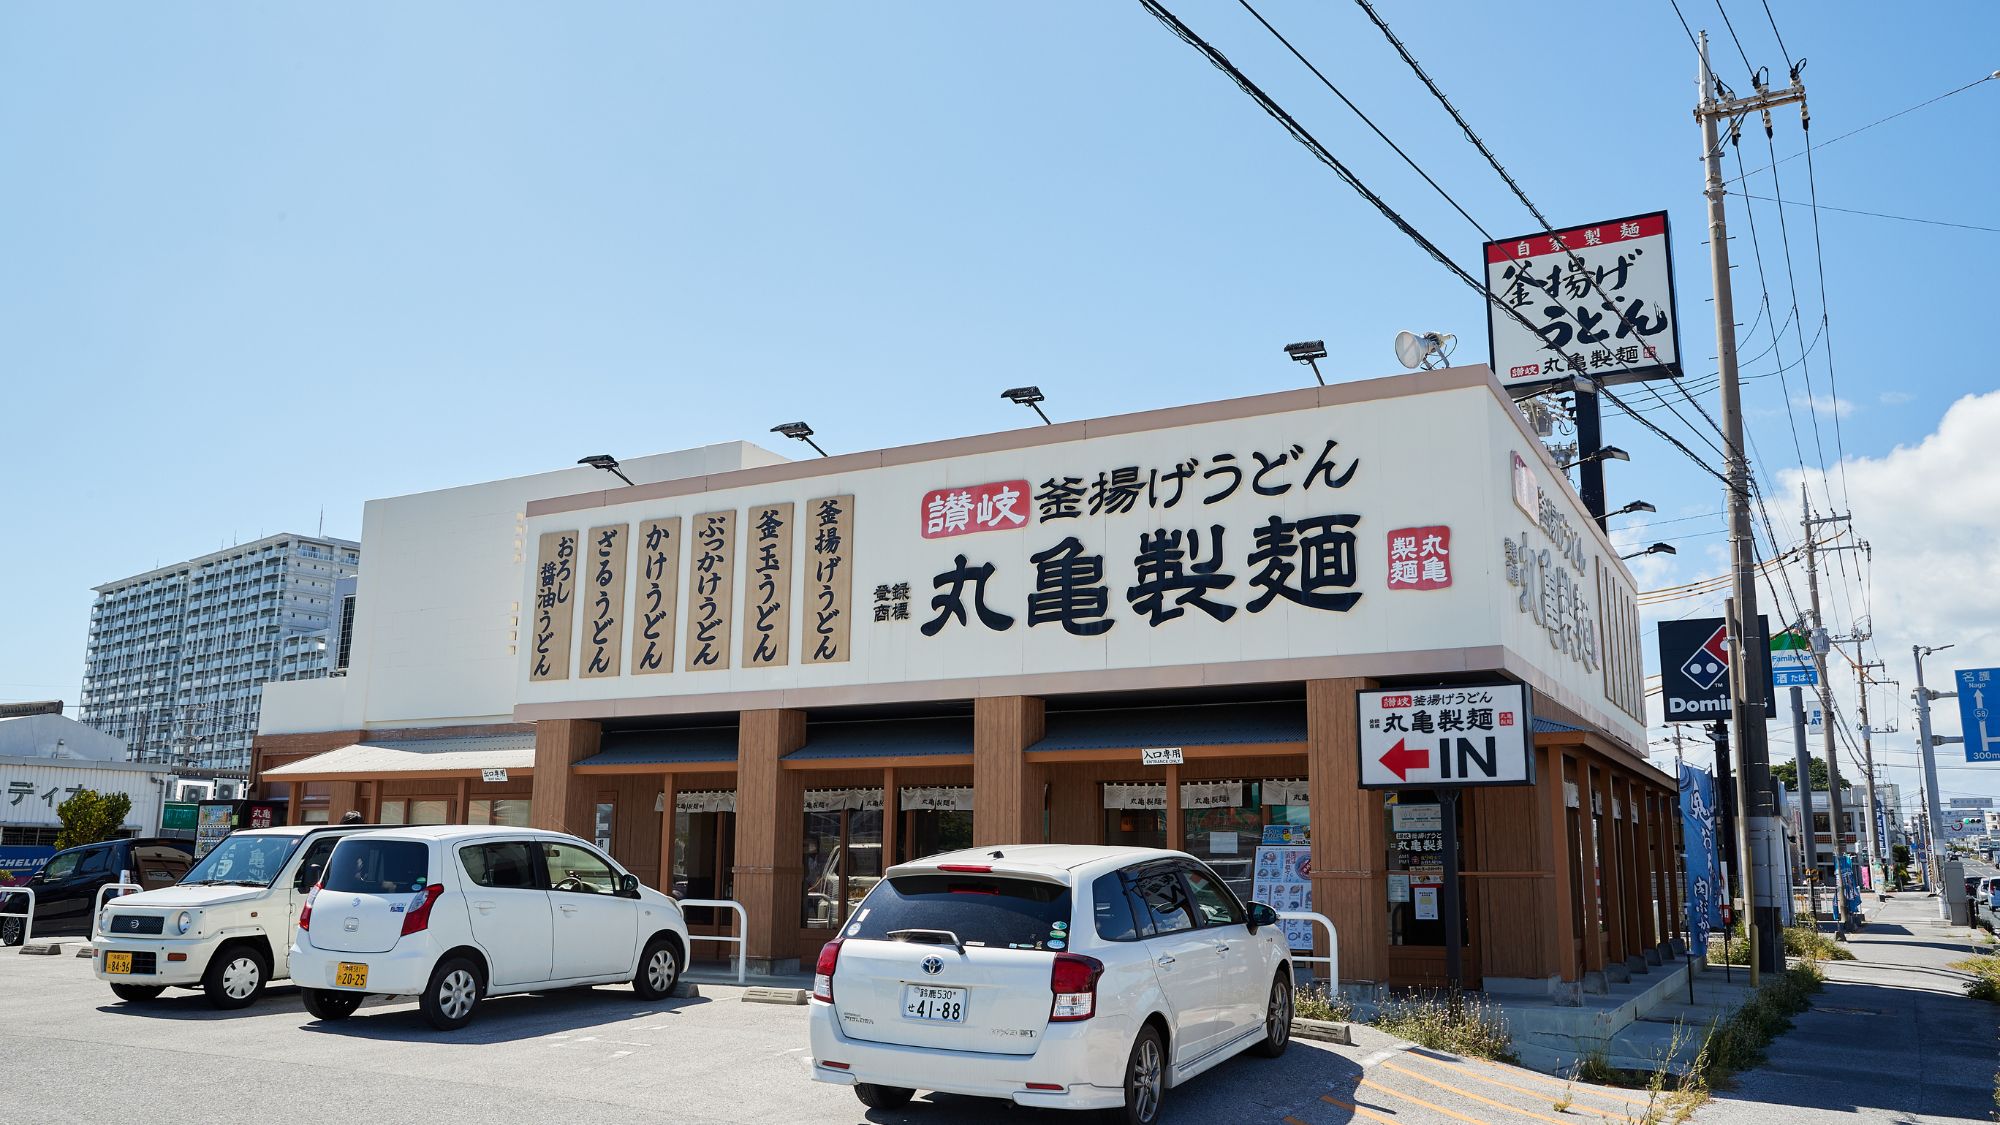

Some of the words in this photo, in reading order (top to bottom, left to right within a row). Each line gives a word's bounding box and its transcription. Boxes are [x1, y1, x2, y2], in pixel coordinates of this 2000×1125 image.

[1517, 222, 1640, 256] 自家製麺
[1500, 248, 1643, 309] 釜揚げ
[1536, 295, 1668, 352] うどん
[1542, 345, 1640, 375] 丸亀製麺
[1034, 438, 1360, 524] 釜揚げうどん
[928, 485, 1027, 532] 讃岐
[556, 536, 575, 604] おろし
[752, 509, 784, 663] 釜玉うどん
[813, 499, 843, 661] 釜揚げうどん
[920, 514, 1363, 637] 丸亀製麺
[588, 529, 618, 674] ざるうどん
[639, 524, 670, 671] かけうどん
[692, 516, 727, 667] ぶっかけうどん
[533, 561, 558, 677] 醤油うどん
[1772, 654, 1813, 662] FamilyMar
[1962, 671, 1991, 682] 名護
[1776, 673, 1788, 684] 酒
[1791, 673, 1814, 682] たばこ
[1412, 691, 1493, 707] 釜揚げうどん
[1669, 694, 1732, 713] Domi
[1383, 708, 1494, 734] 丸亀製麺
[1144, 749, 1181, 760] 入口専用
[1439, 736, 1497, 779] IN
[1973, 752, 2000, 760] 300m
[252, 809, 271, 819] 丸亀
[342, 972, 365, 985] 20-25
[908, 1003, 915, 1012] せ
[917, 1000, 961, 1020] 41-88
